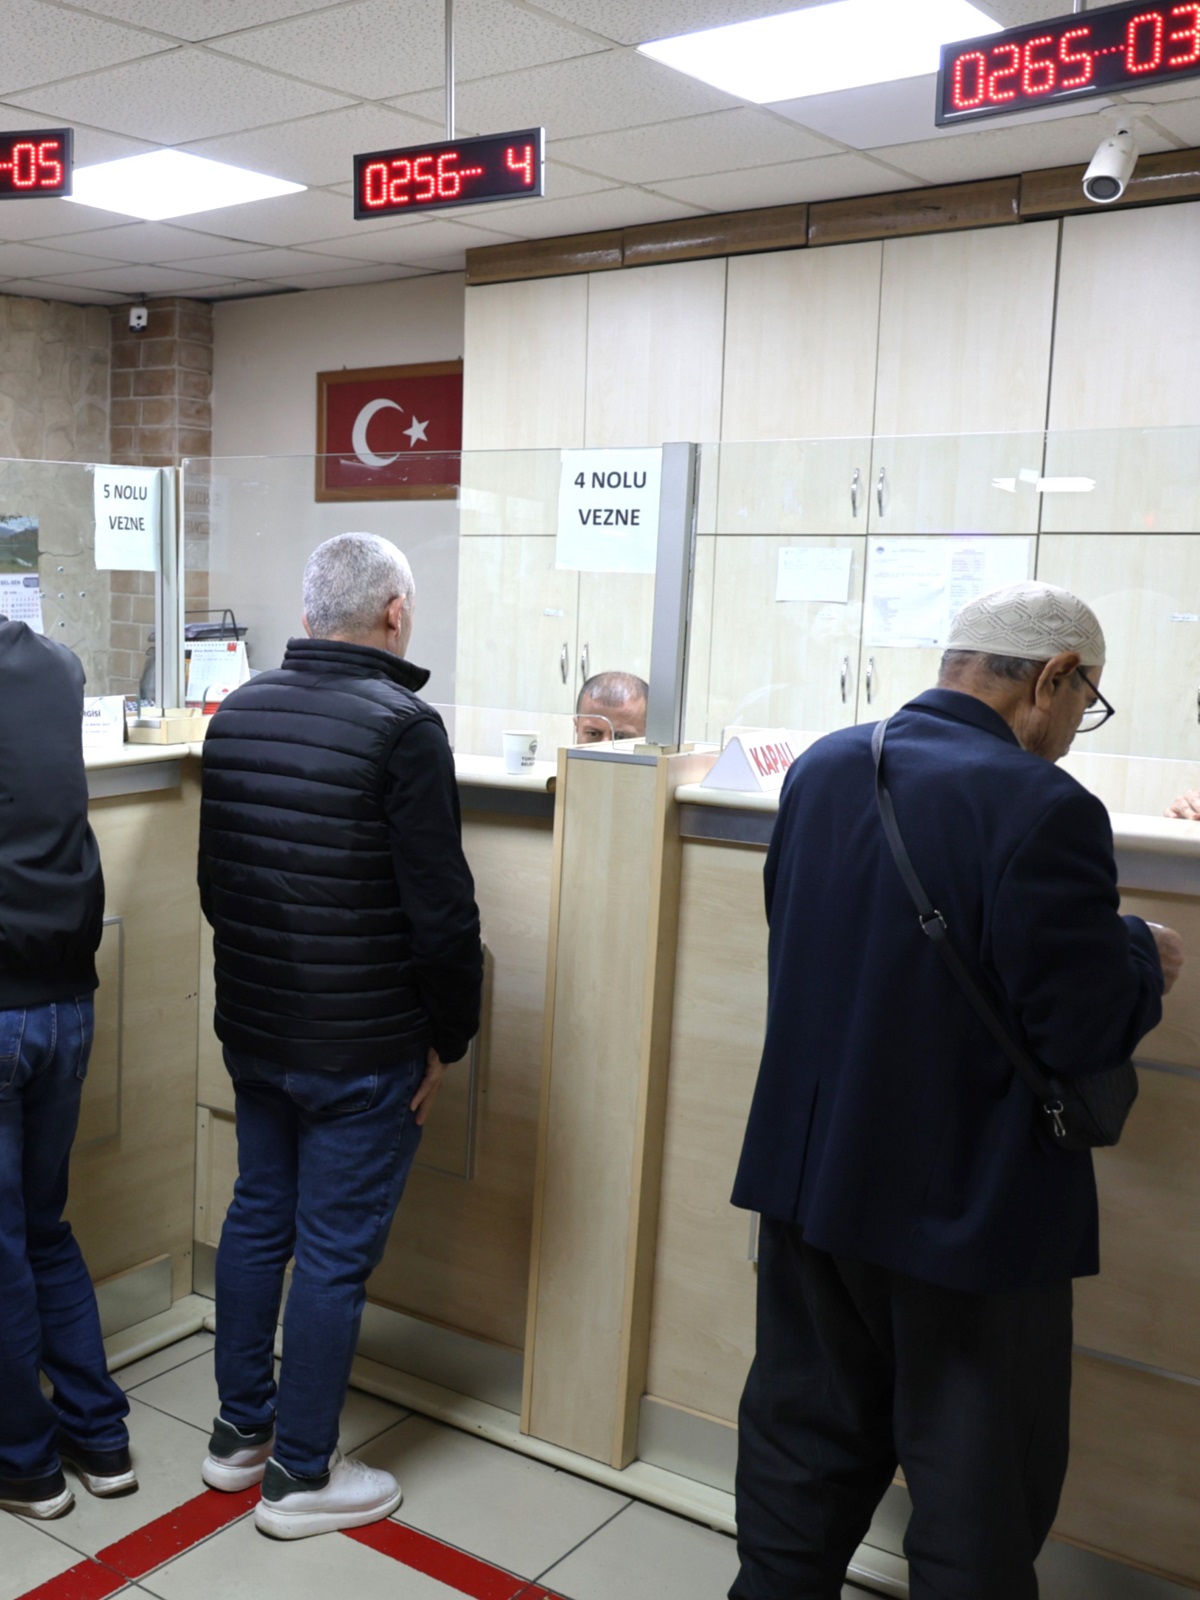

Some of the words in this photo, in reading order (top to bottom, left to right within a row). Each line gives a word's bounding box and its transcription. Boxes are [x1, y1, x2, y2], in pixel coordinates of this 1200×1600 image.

[954, 3, 1200, 107] 0265-03
[507, 146, 531, 184] 4
[574, 471, 586, 489] 4
[591, 471, 647, 489] NOLU
[103, 484, 111, 499] 5
[113, 485, 148, 501] NOLU
[108, 515, 146, 531] VEZNE
[578, 508, 641, 526] VEZNE
[82, 709, 101, 718] RGİSİ
